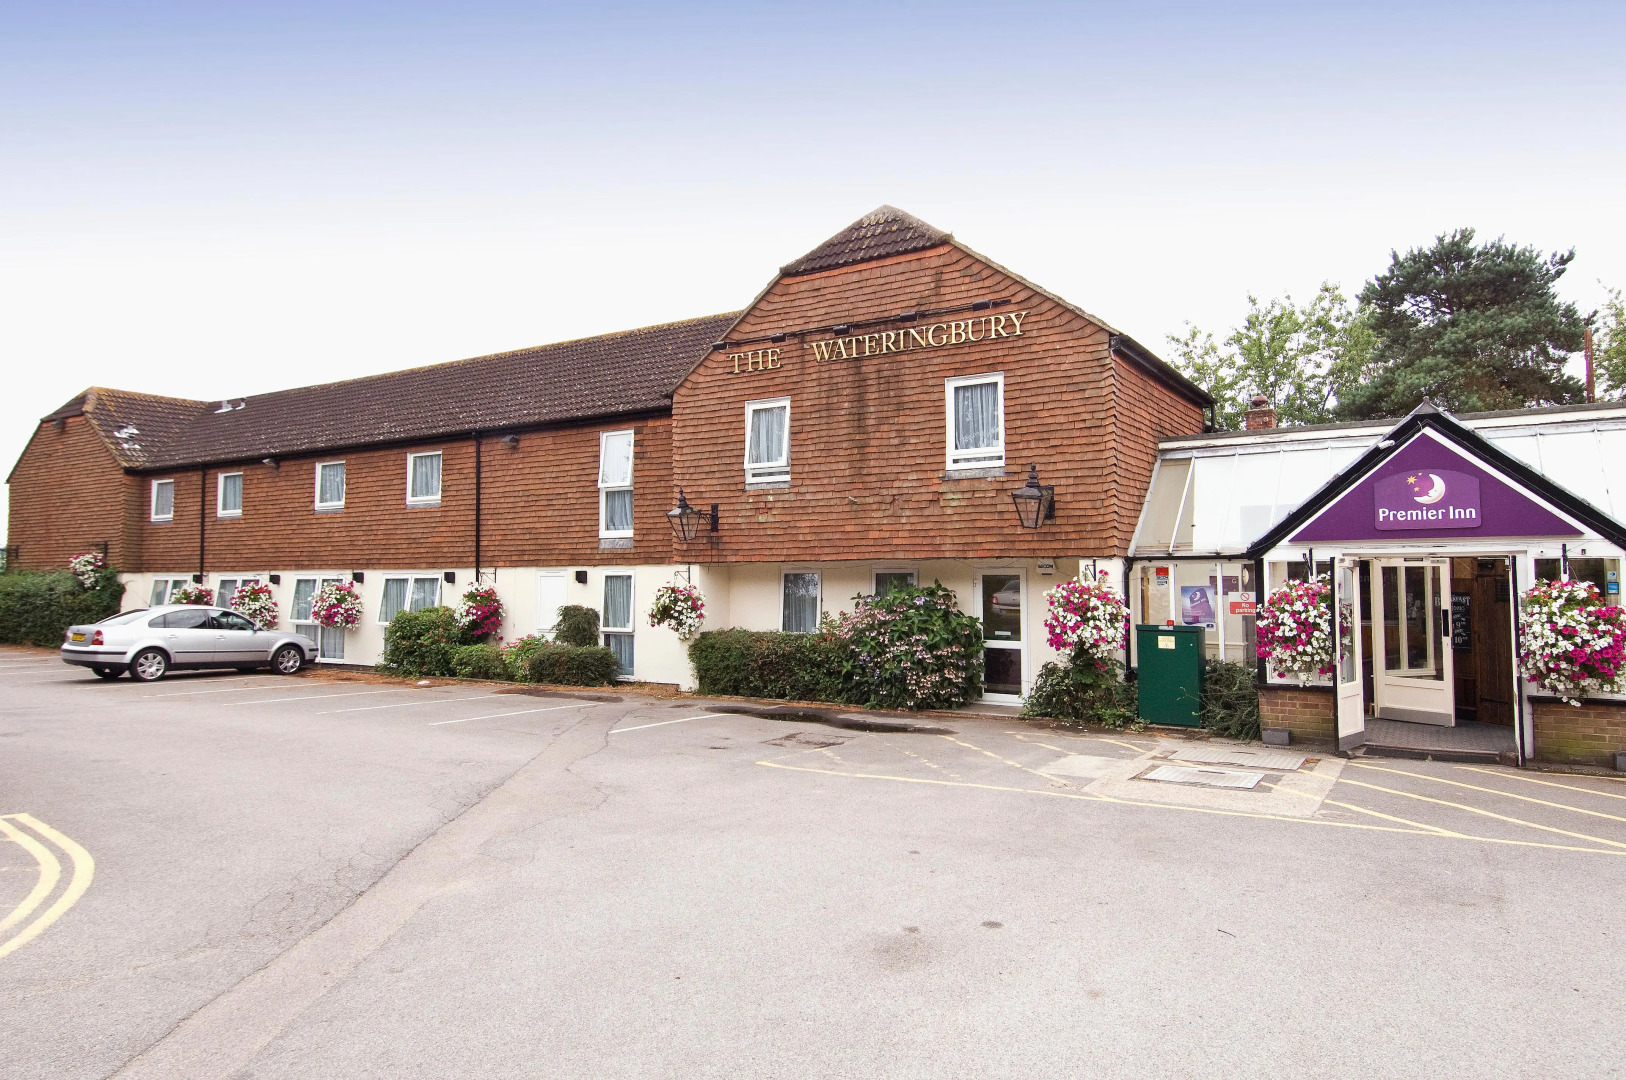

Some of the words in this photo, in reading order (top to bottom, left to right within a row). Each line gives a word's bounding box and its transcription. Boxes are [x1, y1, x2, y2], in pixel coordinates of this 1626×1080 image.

[729, 348, 781, 374] THE
[811, 311, 1029, 363] WATERINGBURY
[1378, 506, 1446, 521] Premier
[1449, 505, 1476, 520] Inn
